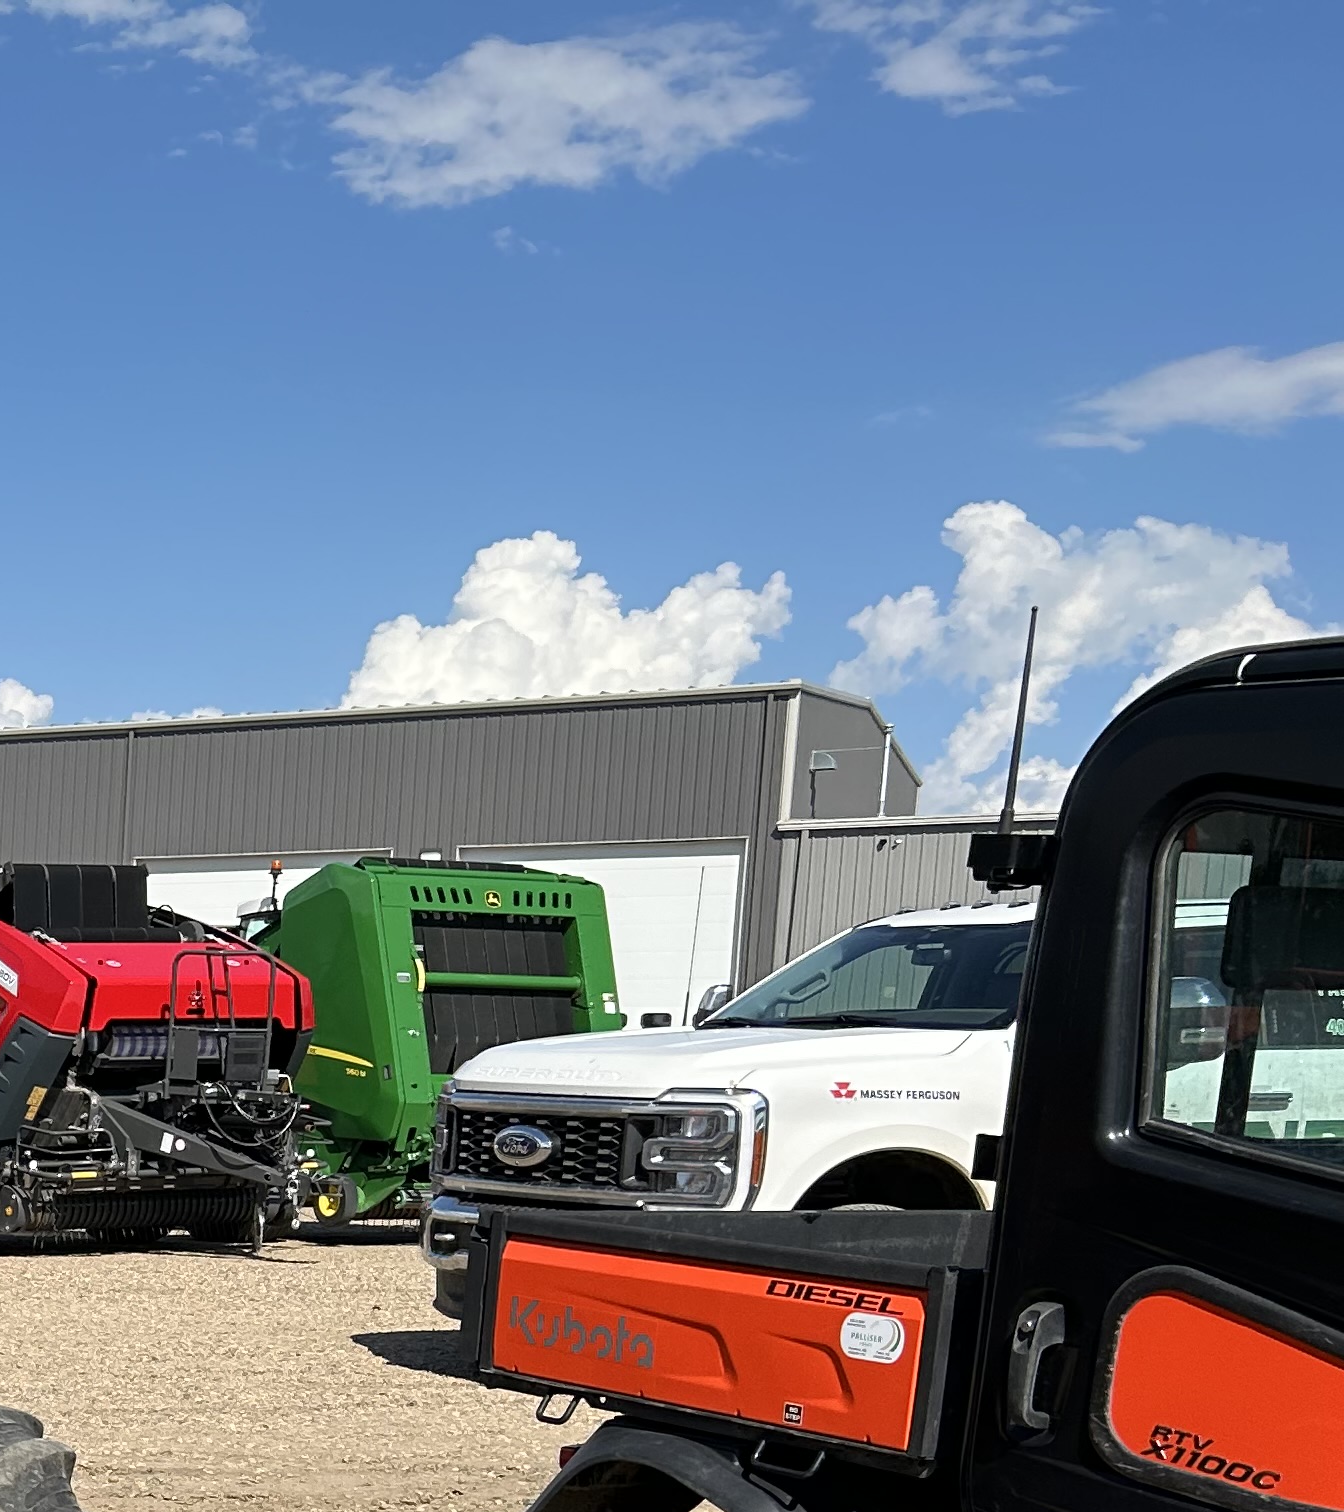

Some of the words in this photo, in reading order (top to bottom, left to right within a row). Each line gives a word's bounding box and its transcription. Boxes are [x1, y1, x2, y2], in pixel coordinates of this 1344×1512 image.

[474, 1066, 552, 1081] SUPER
[861, 1089, 903, 1099] MASSEY
[906, 1090, 961, 1100] FERGUSON
[502, 1136, 530, 1155] Ford
[765, 1279, 904, 1316] DIESEL
[509, 1295, 654, 1370] Kubota
[1150, 1424, 1215, 1451] RTV
[1140, 1437, 1281, 1490] X1100C
